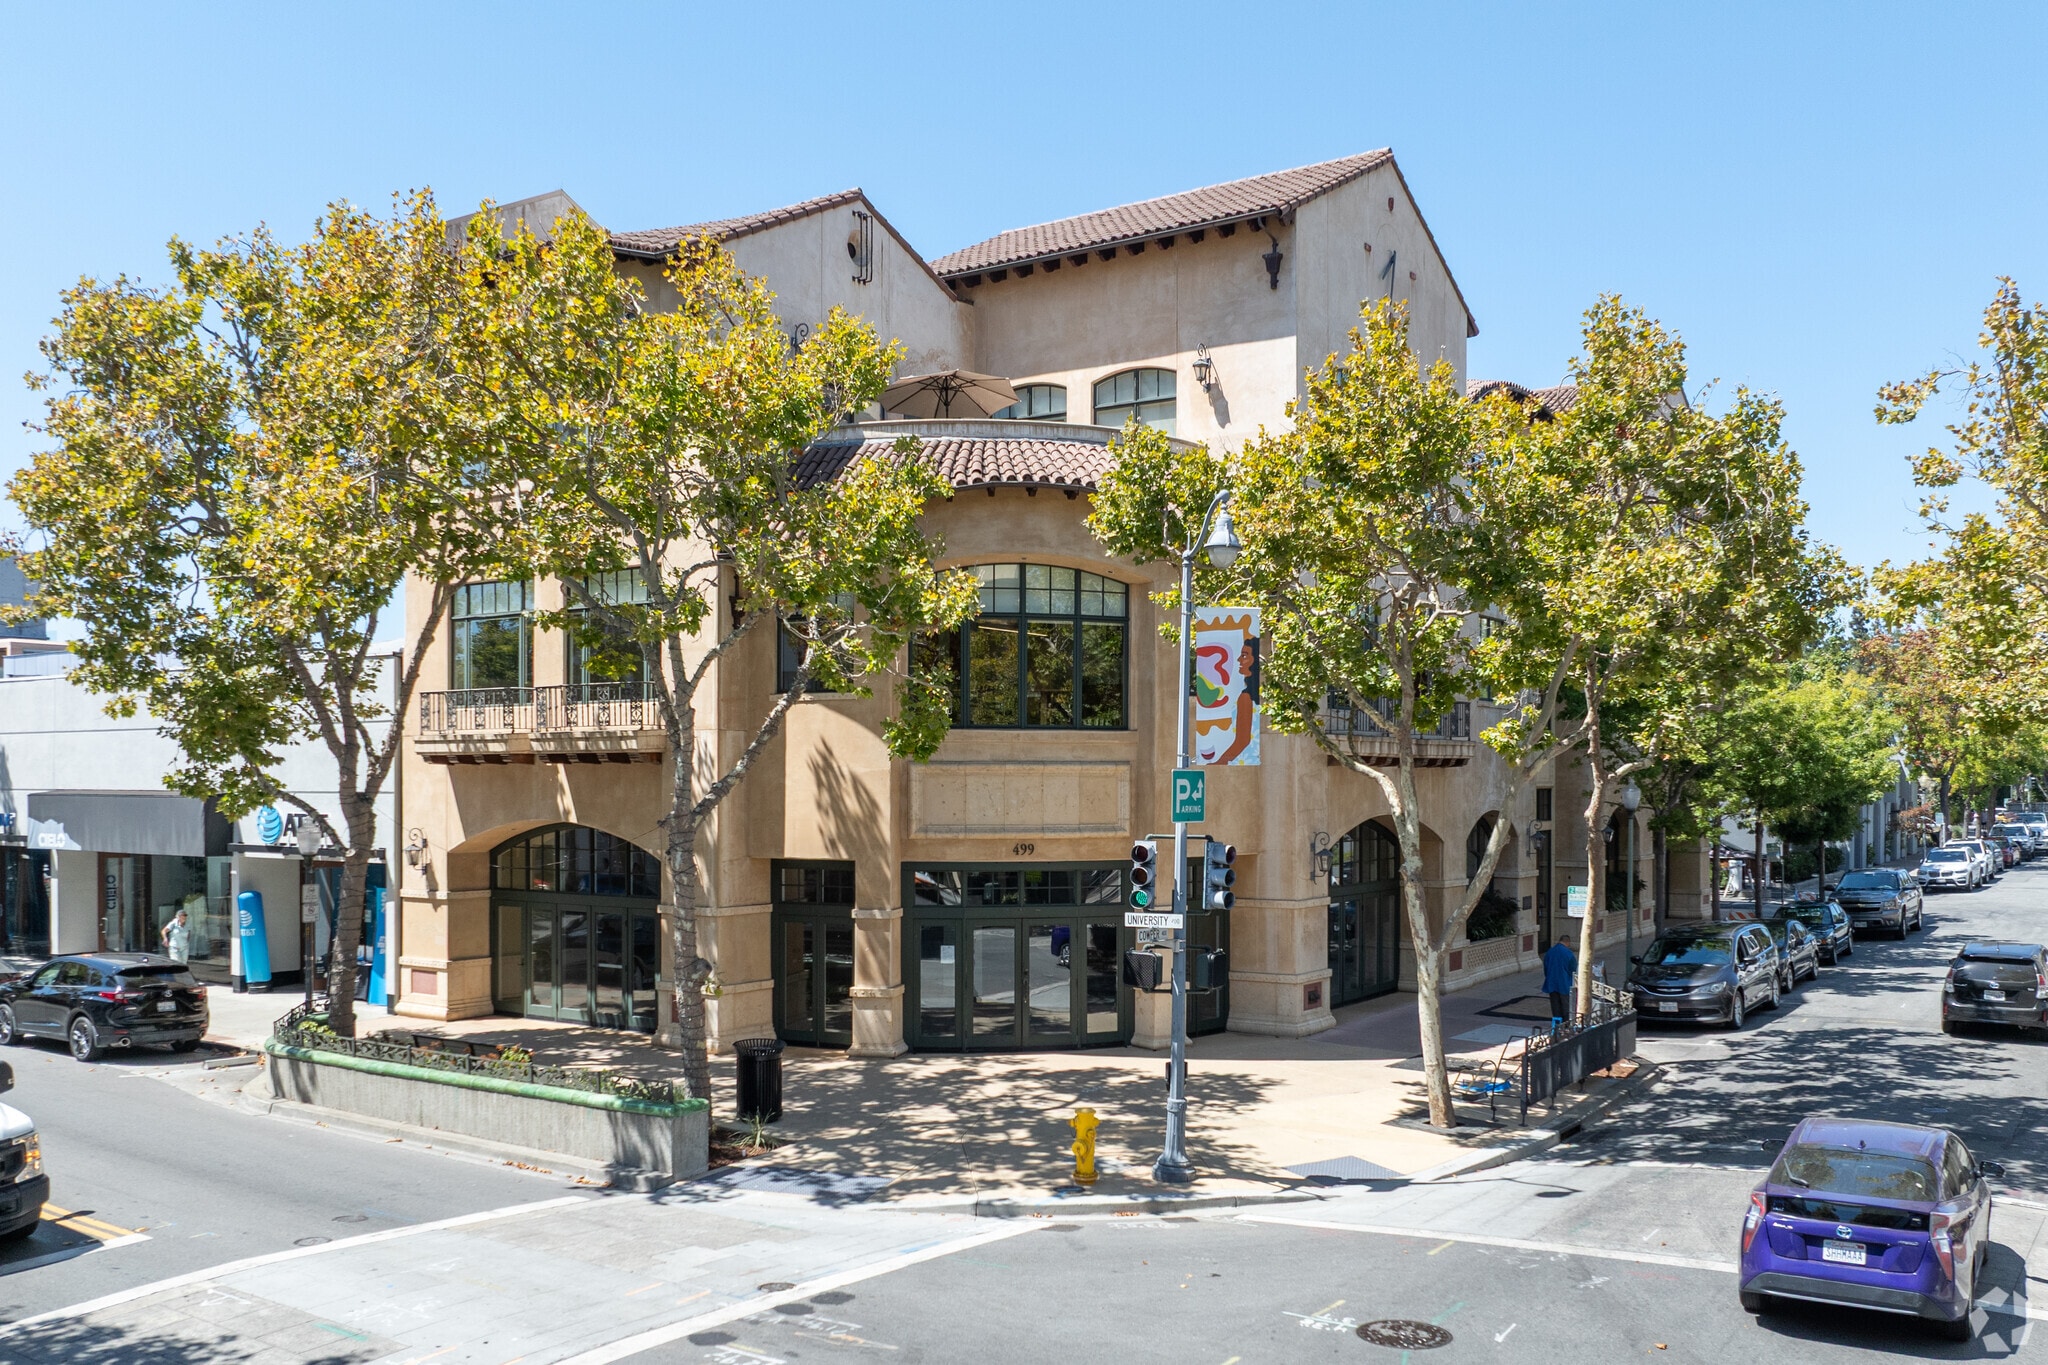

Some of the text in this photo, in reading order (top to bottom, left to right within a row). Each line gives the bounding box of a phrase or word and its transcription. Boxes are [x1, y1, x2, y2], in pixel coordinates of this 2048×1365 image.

[38, 832, 66, 848] CIELO
[1012, 842, 1035, 856] 499
[106, 875, 117, 910] CIELO
[1127, 914, 1169, 926] UNIVERSITY
